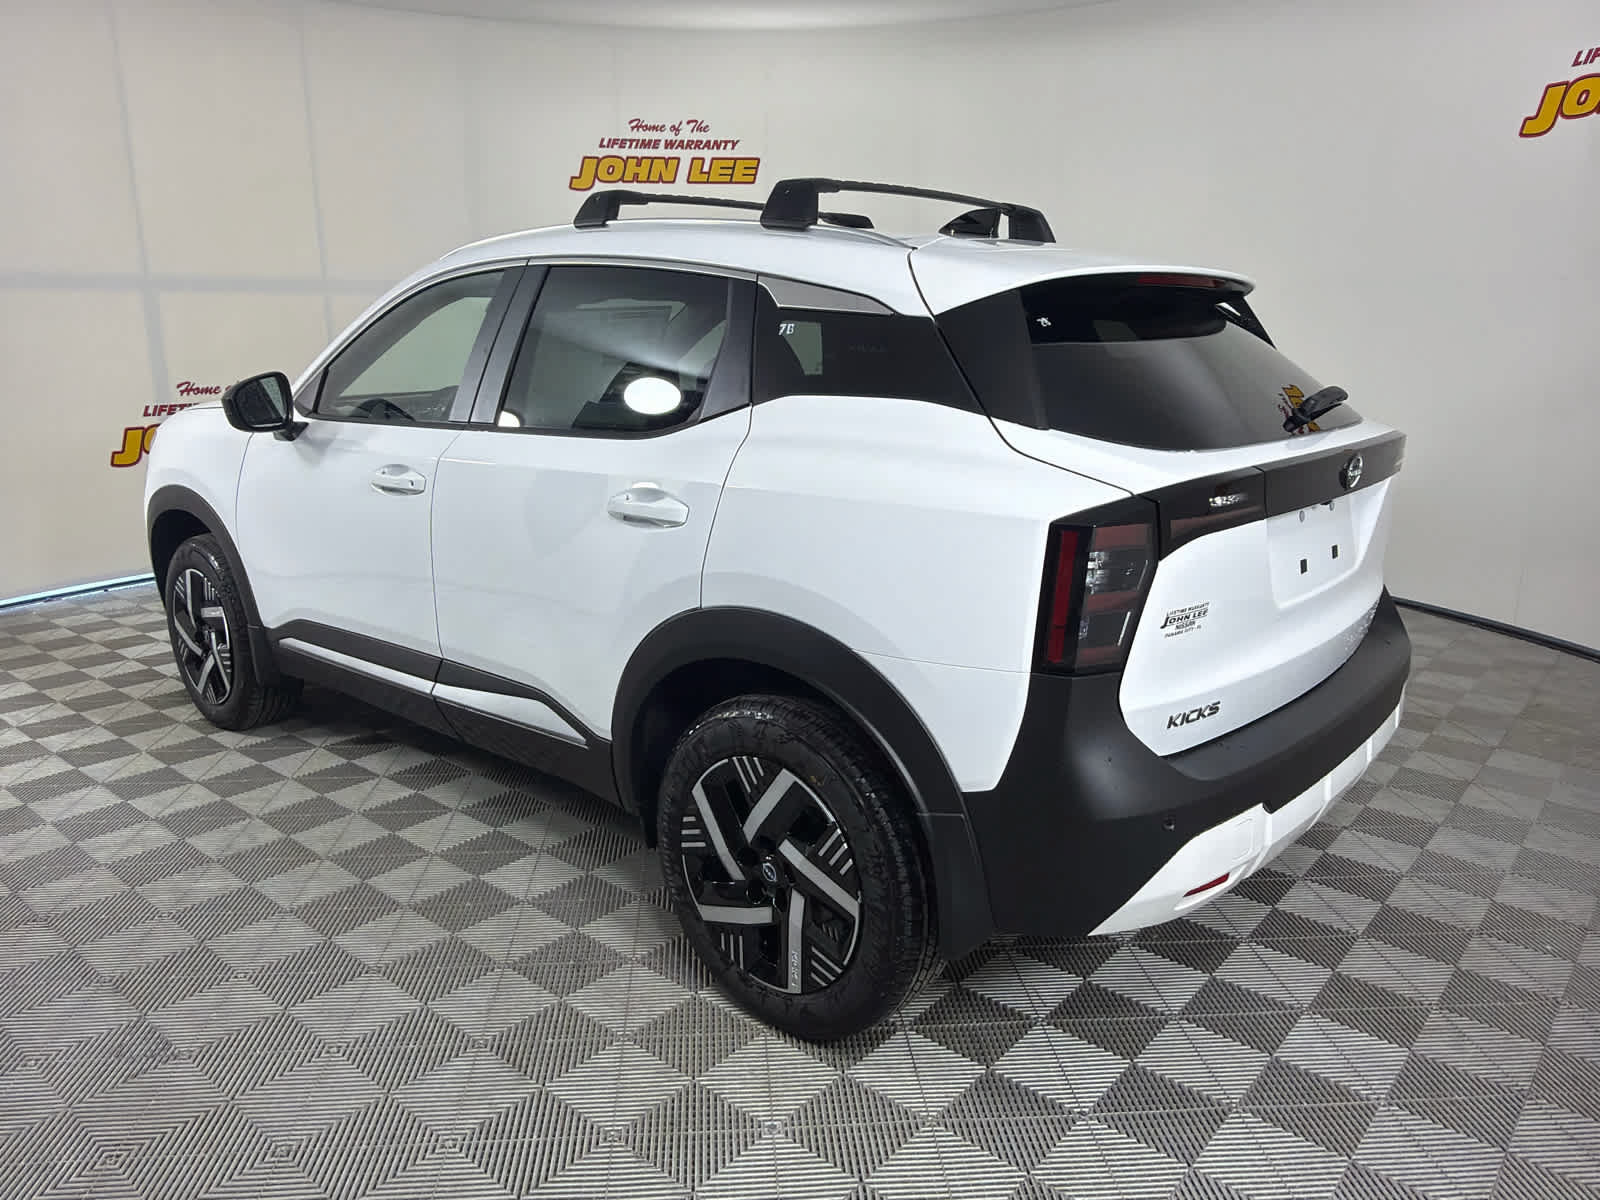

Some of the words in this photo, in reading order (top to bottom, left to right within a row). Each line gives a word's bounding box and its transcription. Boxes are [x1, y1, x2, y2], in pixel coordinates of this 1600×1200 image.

[628, 118, 666, 133] Home
[669, 120, 683, 137] of
[686, 119, 711, 133] The
[598, 138, 661, 150] LIFETIME
[663, 139, 740, 151] WARRANTY
[569, 155, 680, 191] JOHN
[687, 157, 760, 185] LEE
[176, 381, 221, 396] Home
[143, 402, 200, 417] LIFET
[1160, 612, 1191, 629] JOHN
[1192, 608, 1208, 619] LEE
[1167, 701, 1220, 729] KICKS
